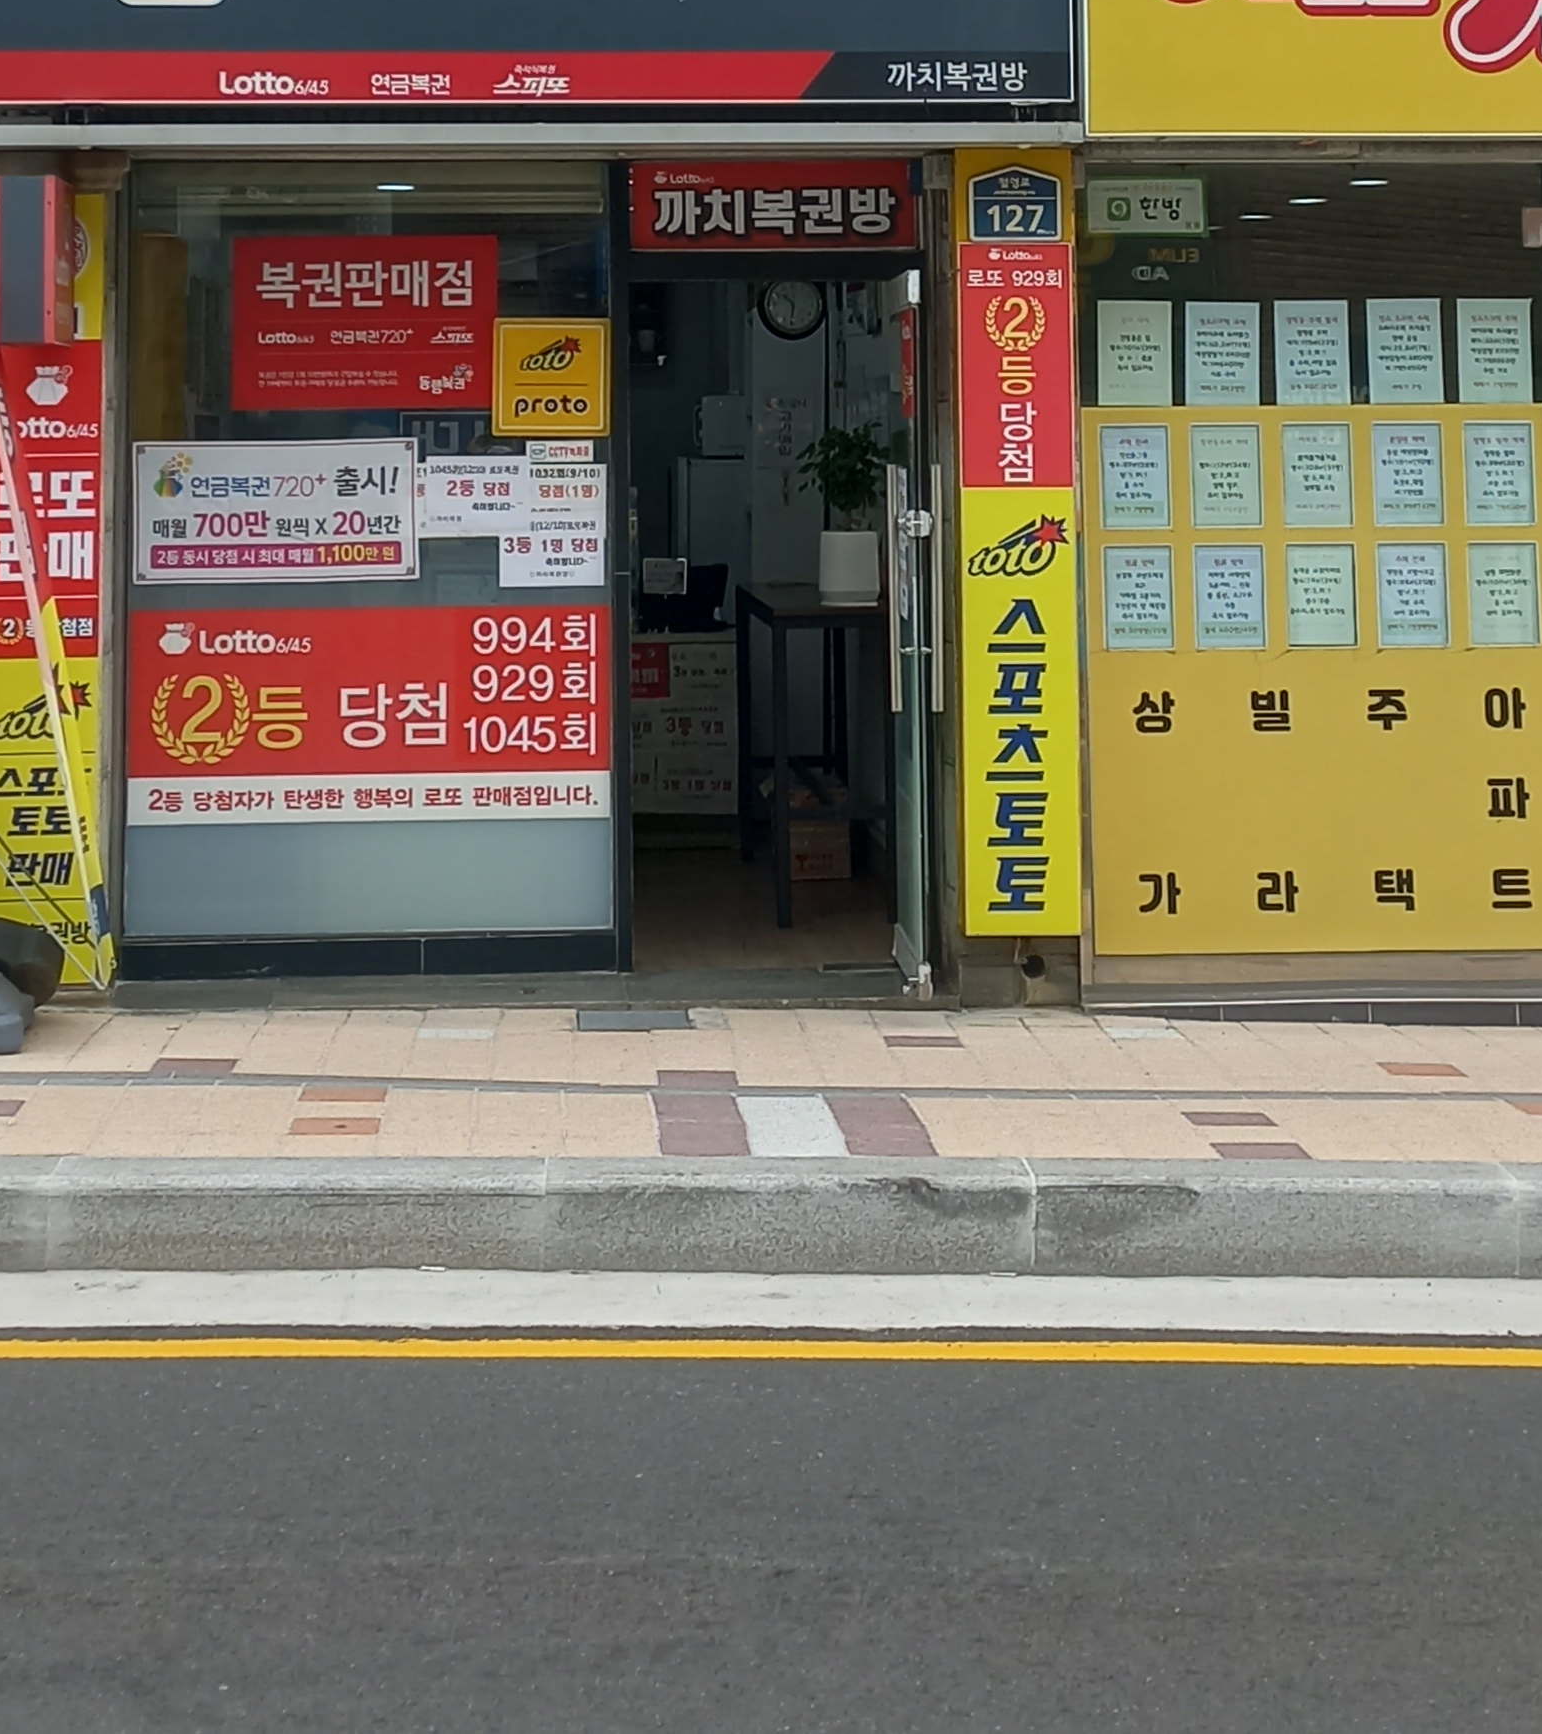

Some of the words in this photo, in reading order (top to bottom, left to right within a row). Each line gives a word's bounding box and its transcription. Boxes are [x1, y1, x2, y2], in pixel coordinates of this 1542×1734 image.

[370, 72, 451, 97] 연금복권
[492, 73, 571, 98] 스피또
[886, 60, 1027, 94] 까치복권방
[651, 186, 896, 238] 까치복권방
[986, 204, 1045, 233] 127
[1138, 195, 1184, 222] 한방
[256, 259, 474, 309] 복권판매점
[966, 268, 1005, 289] 로또
[1011, 267, 1064, 290] 929회
[513, 394, 589, 418] proto
[16, 417, 99, 439] otto6/45
[995, 398, 1038, 484] 당첨
[332, 465, 400, 498] 출시!
[445, 478, 476, 497] 2등
[152, 518, 188, 539] 매월
[192, 509, 272, 539] 700만
[275, 517, 311, 538] 원씩
[331, 509, 403, 537] 20년간
[156, 549, 180, 566] 2등
[258, 547, 286, 565] 최대
[316, 543, 379, 565] 1,100만
[967, 534, 1056, 578] toto
[1, 617, 94, 640] 2등첨점
[470, 612, 598, 658] 994회
[471, 660, 598, 705] 929회
[179, 674, 309, 751] 2등
[338, 680, 450, 750] 당첨
[461, 710, 597, 757] 1045회
[984, 597, 1051, 913] 스포츠토토
[147, 788, 185, 813] 2등
[192, 788, 275, 813] 당첨자가
[283, 787, 346, 812] 탄생한
[353, 785, 414, 811] 행복의
[421, 786, 463, 809] 로또
[471, 784, 599, 809] 판매점입니다.
[6, 805, 75, 838] 토토
[6, 851, 75, 887] 판매
